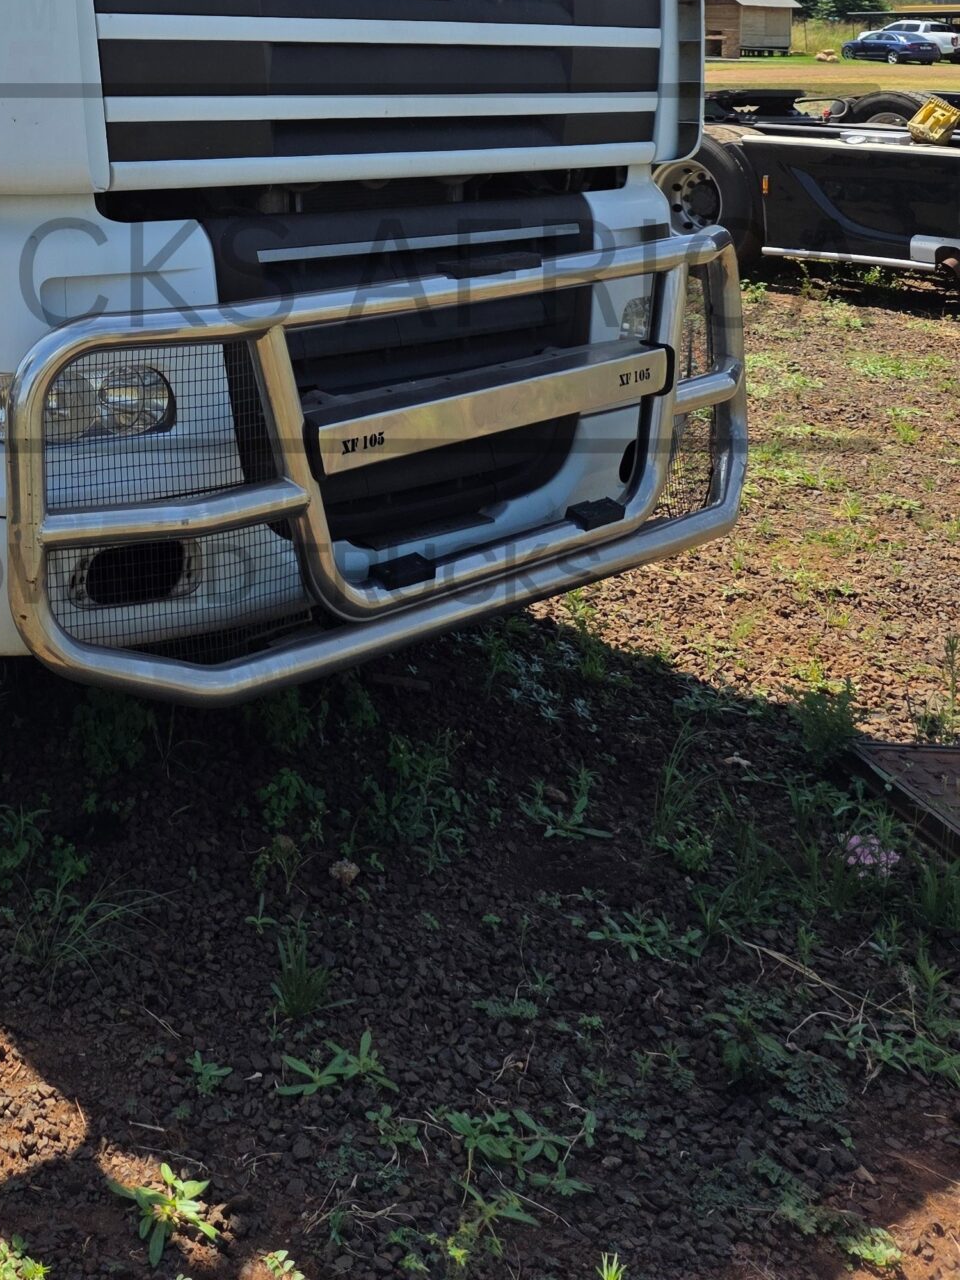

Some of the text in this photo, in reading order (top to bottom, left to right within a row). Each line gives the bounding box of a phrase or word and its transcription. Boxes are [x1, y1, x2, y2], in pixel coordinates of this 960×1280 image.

[619, 367, 650, 387] XF 105
[342, 431, 385, 455] XF 105
